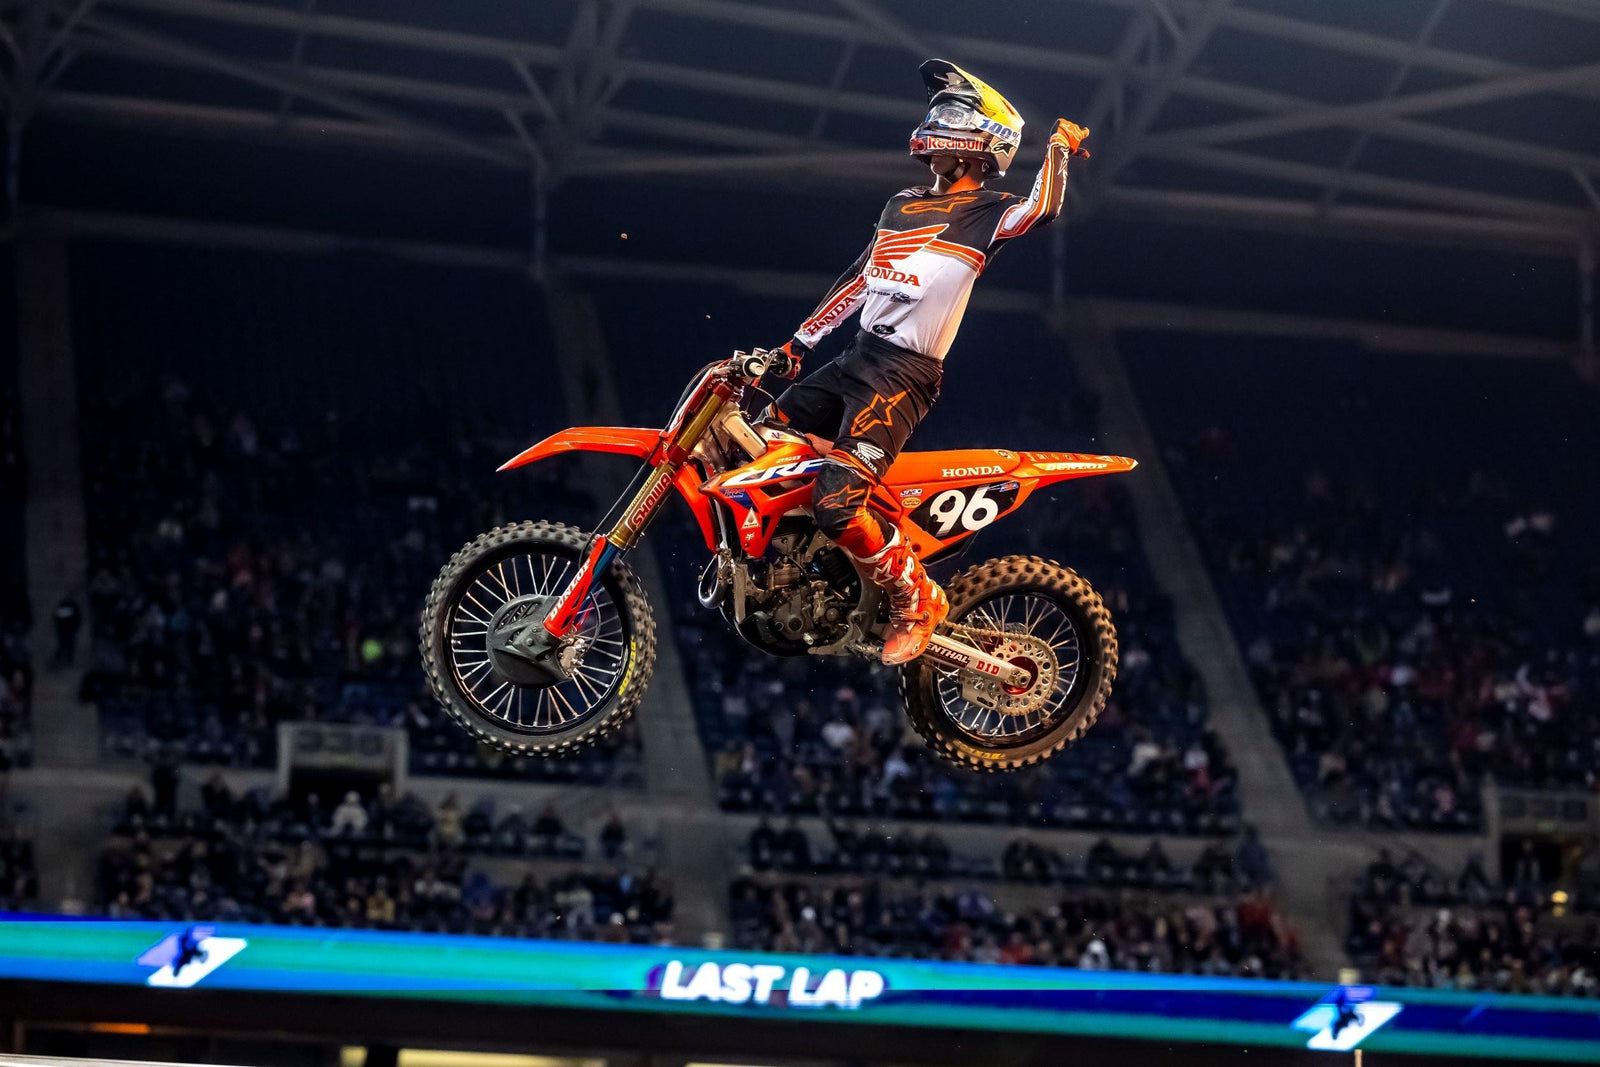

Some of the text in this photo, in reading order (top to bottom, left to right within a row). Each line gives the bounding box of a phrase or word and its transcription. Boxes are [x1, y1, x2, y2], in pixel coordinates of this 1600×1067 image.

[927, 136, 984, 151] Red Bull
[865, 266, 920, 287] HONDA
[807, 296, 857, 336] HONDA
[851, 449, 878, 474] HONDA
[941, 465, 1006, 478] HONDA
[632, 473, 671, 526] SHOWA
[930, 485, 999, 537] 96
[927, 643, 970, 665] ENTHAL
[975, 660, 1001, 676] DID
[660, 959, 885, 1009] LAST LAP
